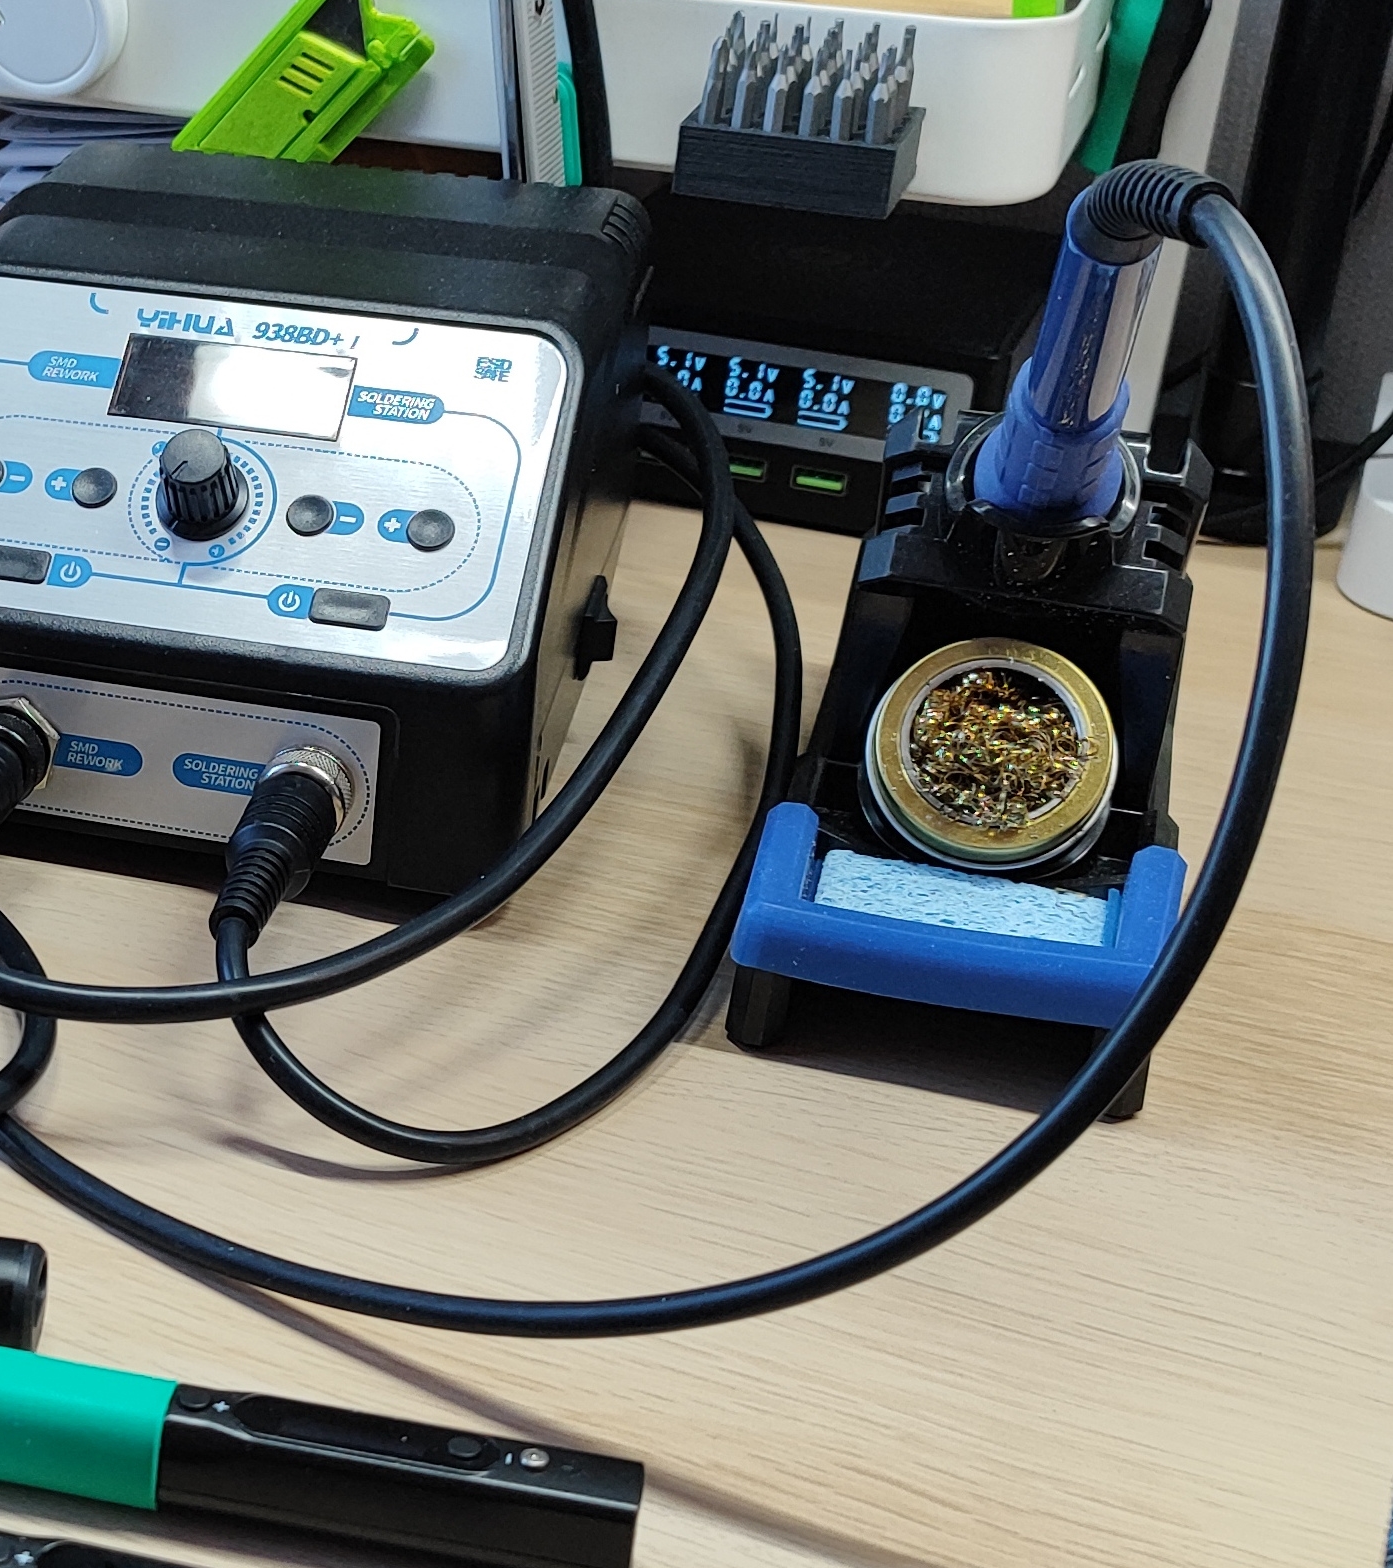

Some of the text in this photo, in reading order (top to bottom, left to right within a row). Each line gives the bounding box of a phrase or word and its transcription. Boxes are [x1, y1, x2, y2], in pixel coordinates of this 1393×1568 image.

[48, 355, 78, 368] SMD
[42, 366, 100, 382] REWORK
[357, 390, 436, 410] SOLDERING
[372, 404, 431, 421] STATION
[69, 740, 99, 755] SMD
[67, 752, 124, 771] REWORK
[183, 758, 259, 780] SOLDERING
[200, 772, 256, 791] STATION
